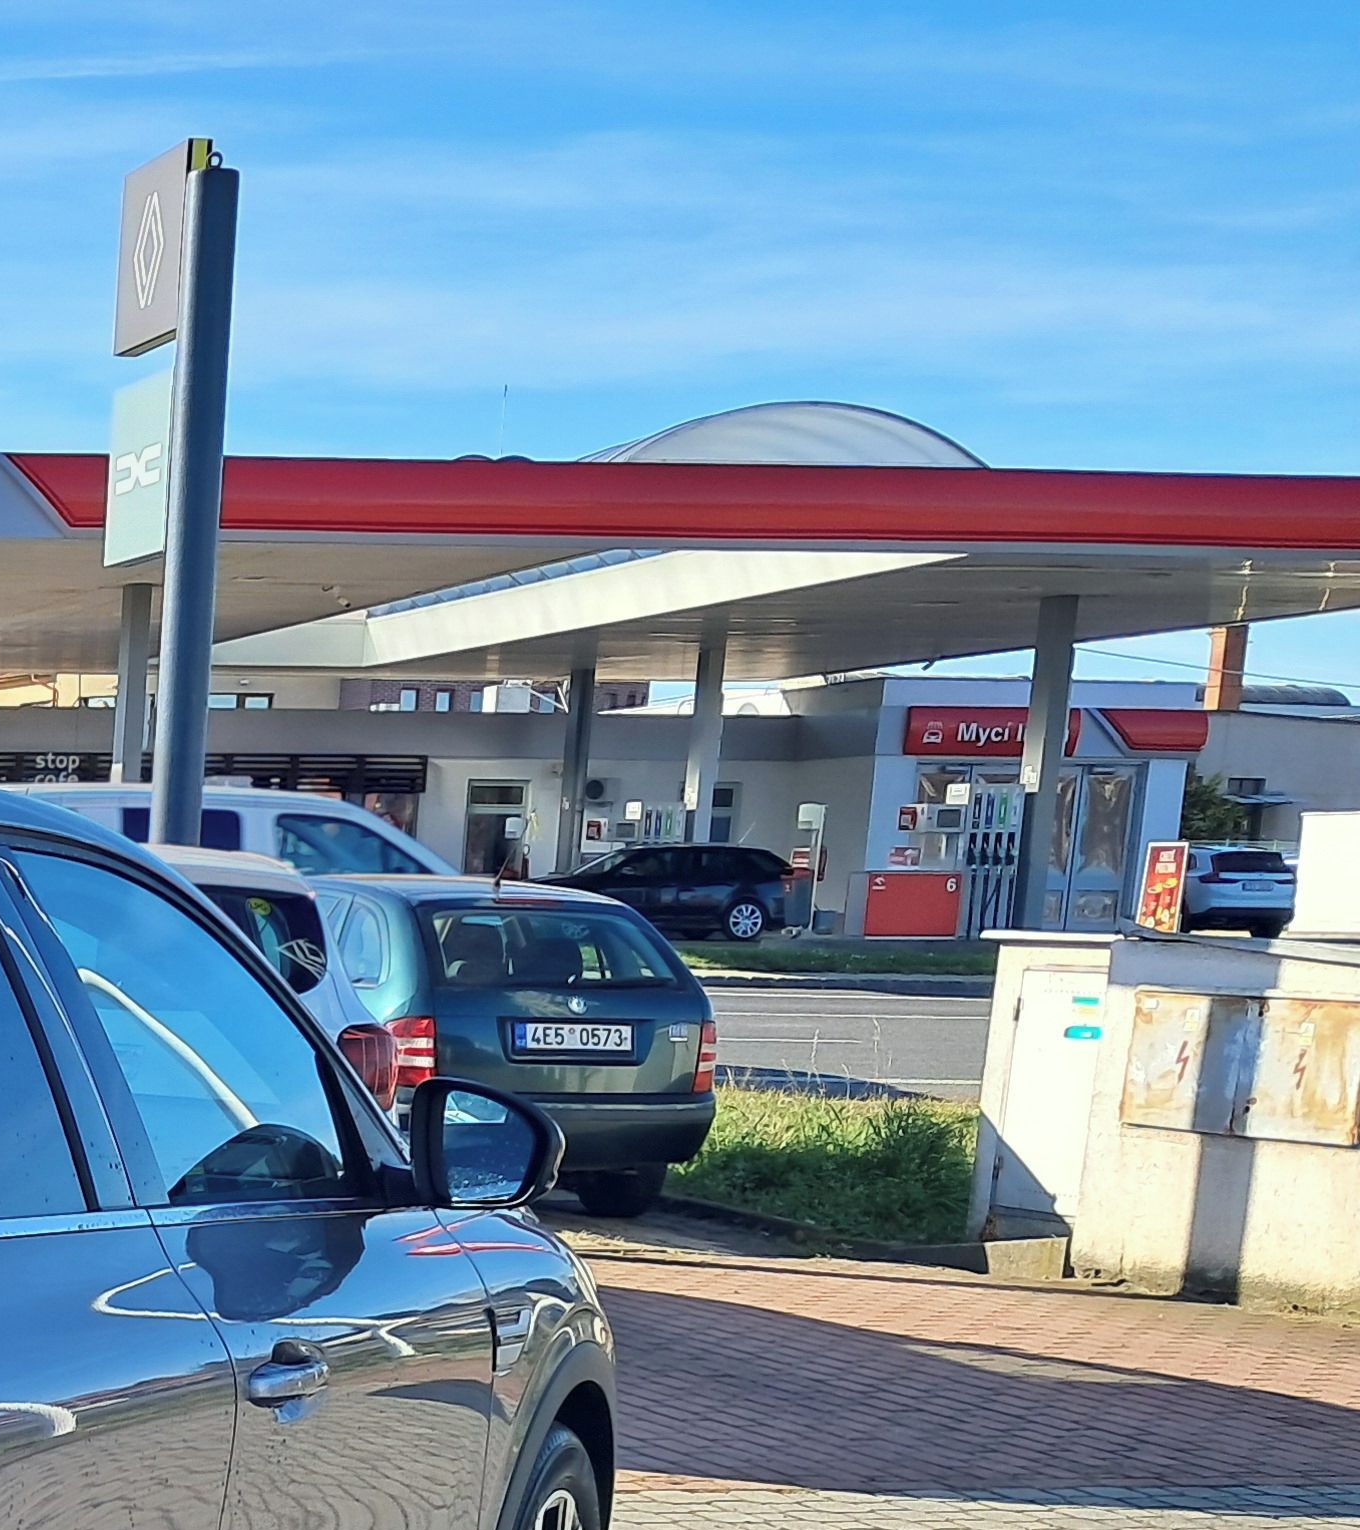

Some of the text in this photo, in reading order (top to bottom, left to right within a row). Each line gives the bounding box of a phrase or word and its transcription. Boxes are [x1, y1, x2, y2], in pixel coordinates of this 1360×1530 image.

[957, 721, 1013, 747] Mycí
[35, 752, 80, 773] stop
[946, 878, 958, 892] 6
[531, 1026, 624, 1047] 4E5 0573
